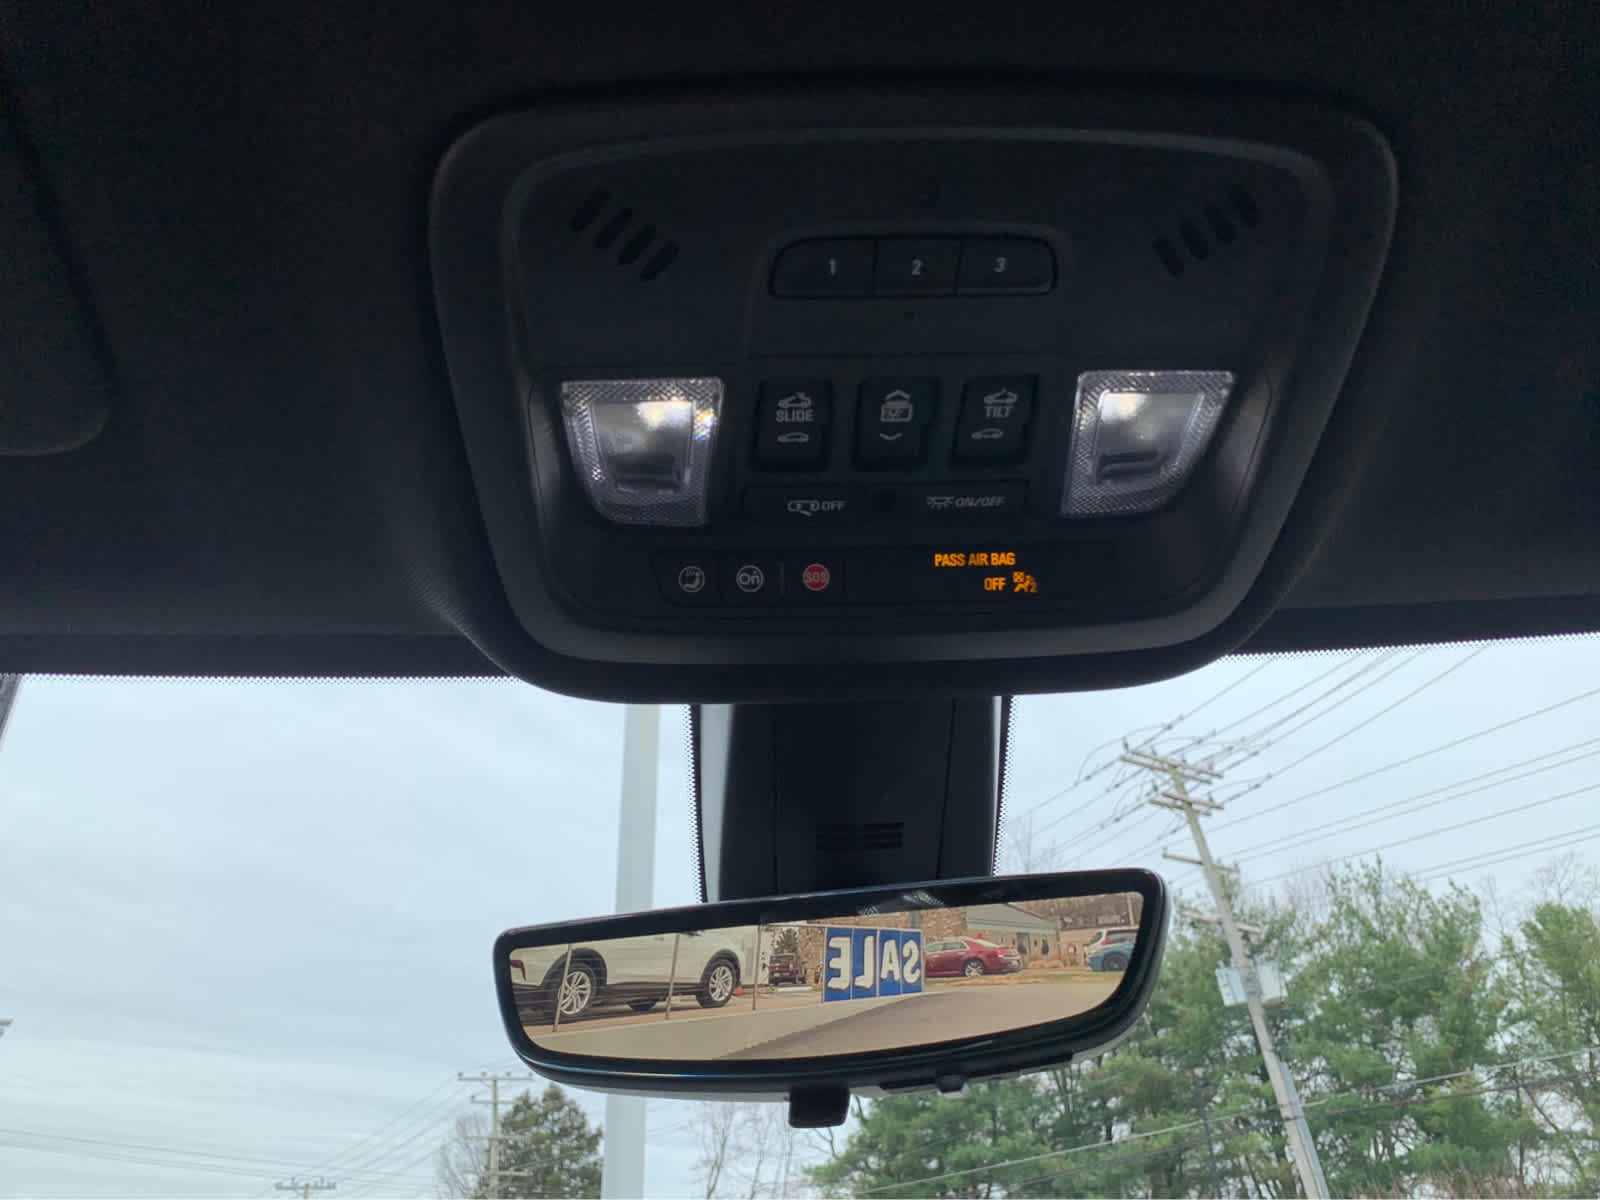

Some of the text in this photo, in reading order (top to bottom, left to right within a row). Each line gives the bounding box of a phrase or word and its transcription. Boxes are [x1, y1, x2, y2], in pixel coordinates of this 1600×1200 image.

[828, 258, 837, 275] 1
[911, 259, 923, 276] 2
[993, 257, 1006, 273] 3
[775, 409, 814, 423] SLIDE
[984, 405, 1013, 418] TILT
[821, 500, 848, 512] OFF
[955, 496, 1008, 508] ON/OFF
[934, 552, 1016, 568] PASS AIR BAG
[983, 577, 1006, 591] OFF
